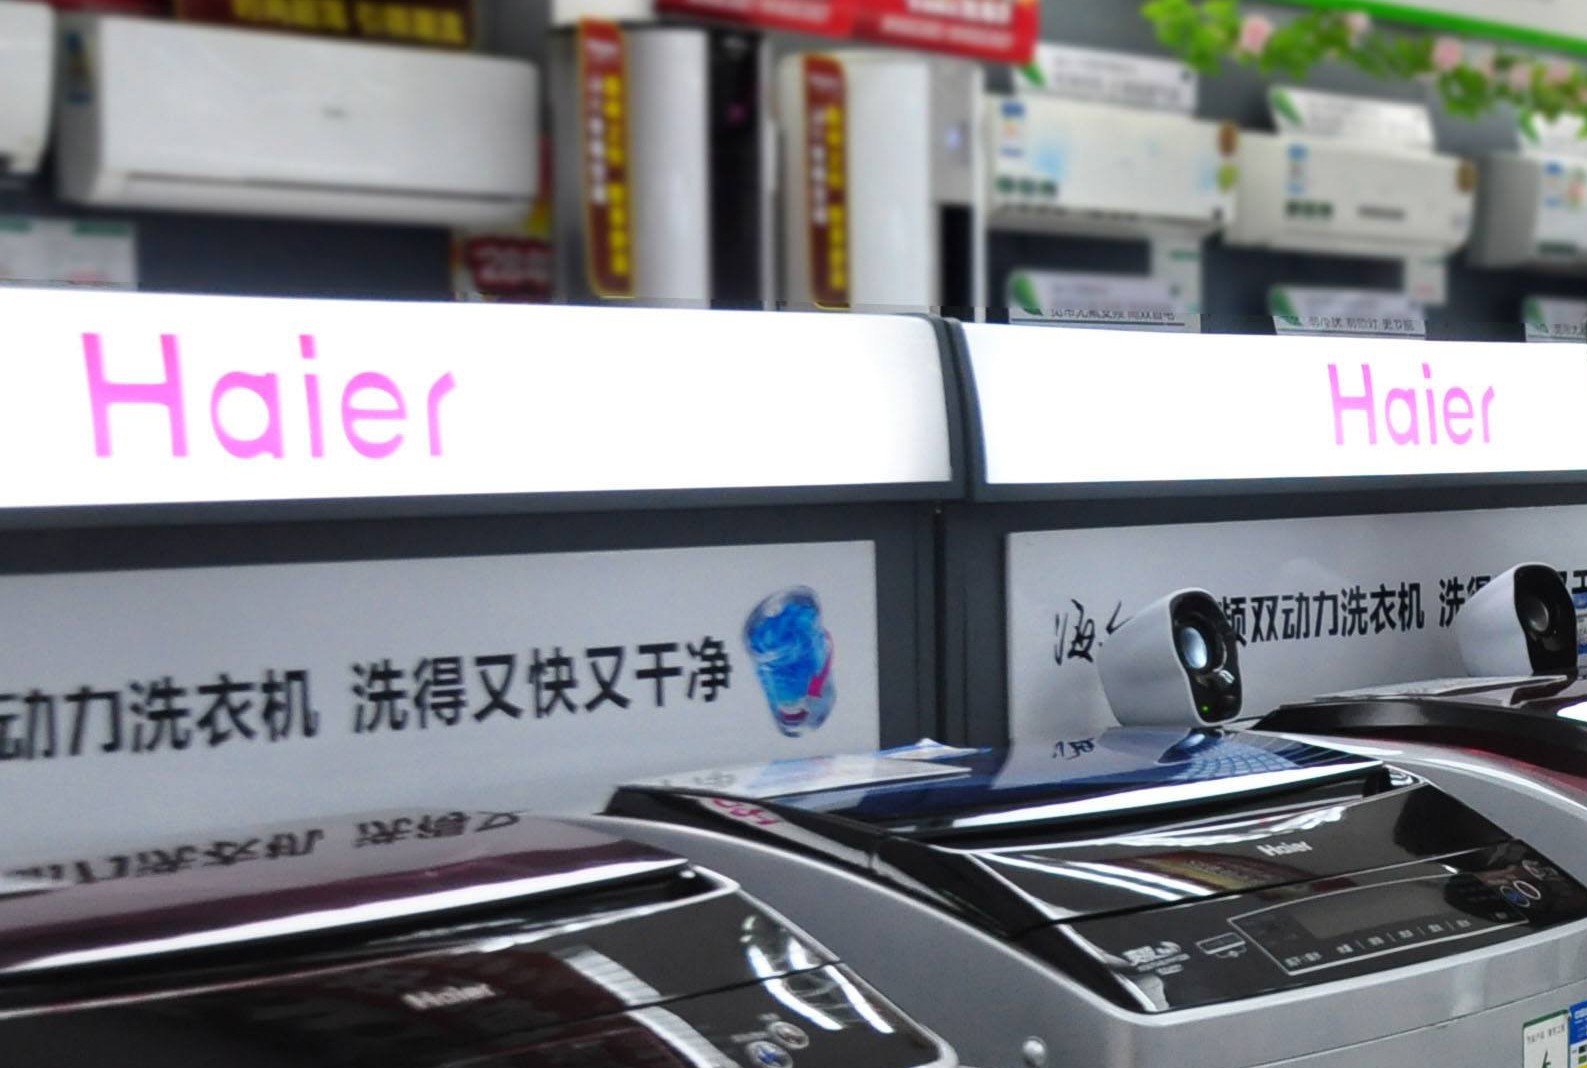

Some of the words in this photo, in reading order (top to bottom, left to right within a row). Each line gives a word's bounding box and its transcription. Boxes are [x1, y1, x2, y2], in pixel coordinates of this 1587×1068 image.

[81, 332, 457, 460] Haier
[1327, 362, 1496, 447] Haier
[351, 635, 733, 734] 洗得又快又干净
[1256, 838, 1314, 857] Haier
[402, 981, 496, 1010] Haier
